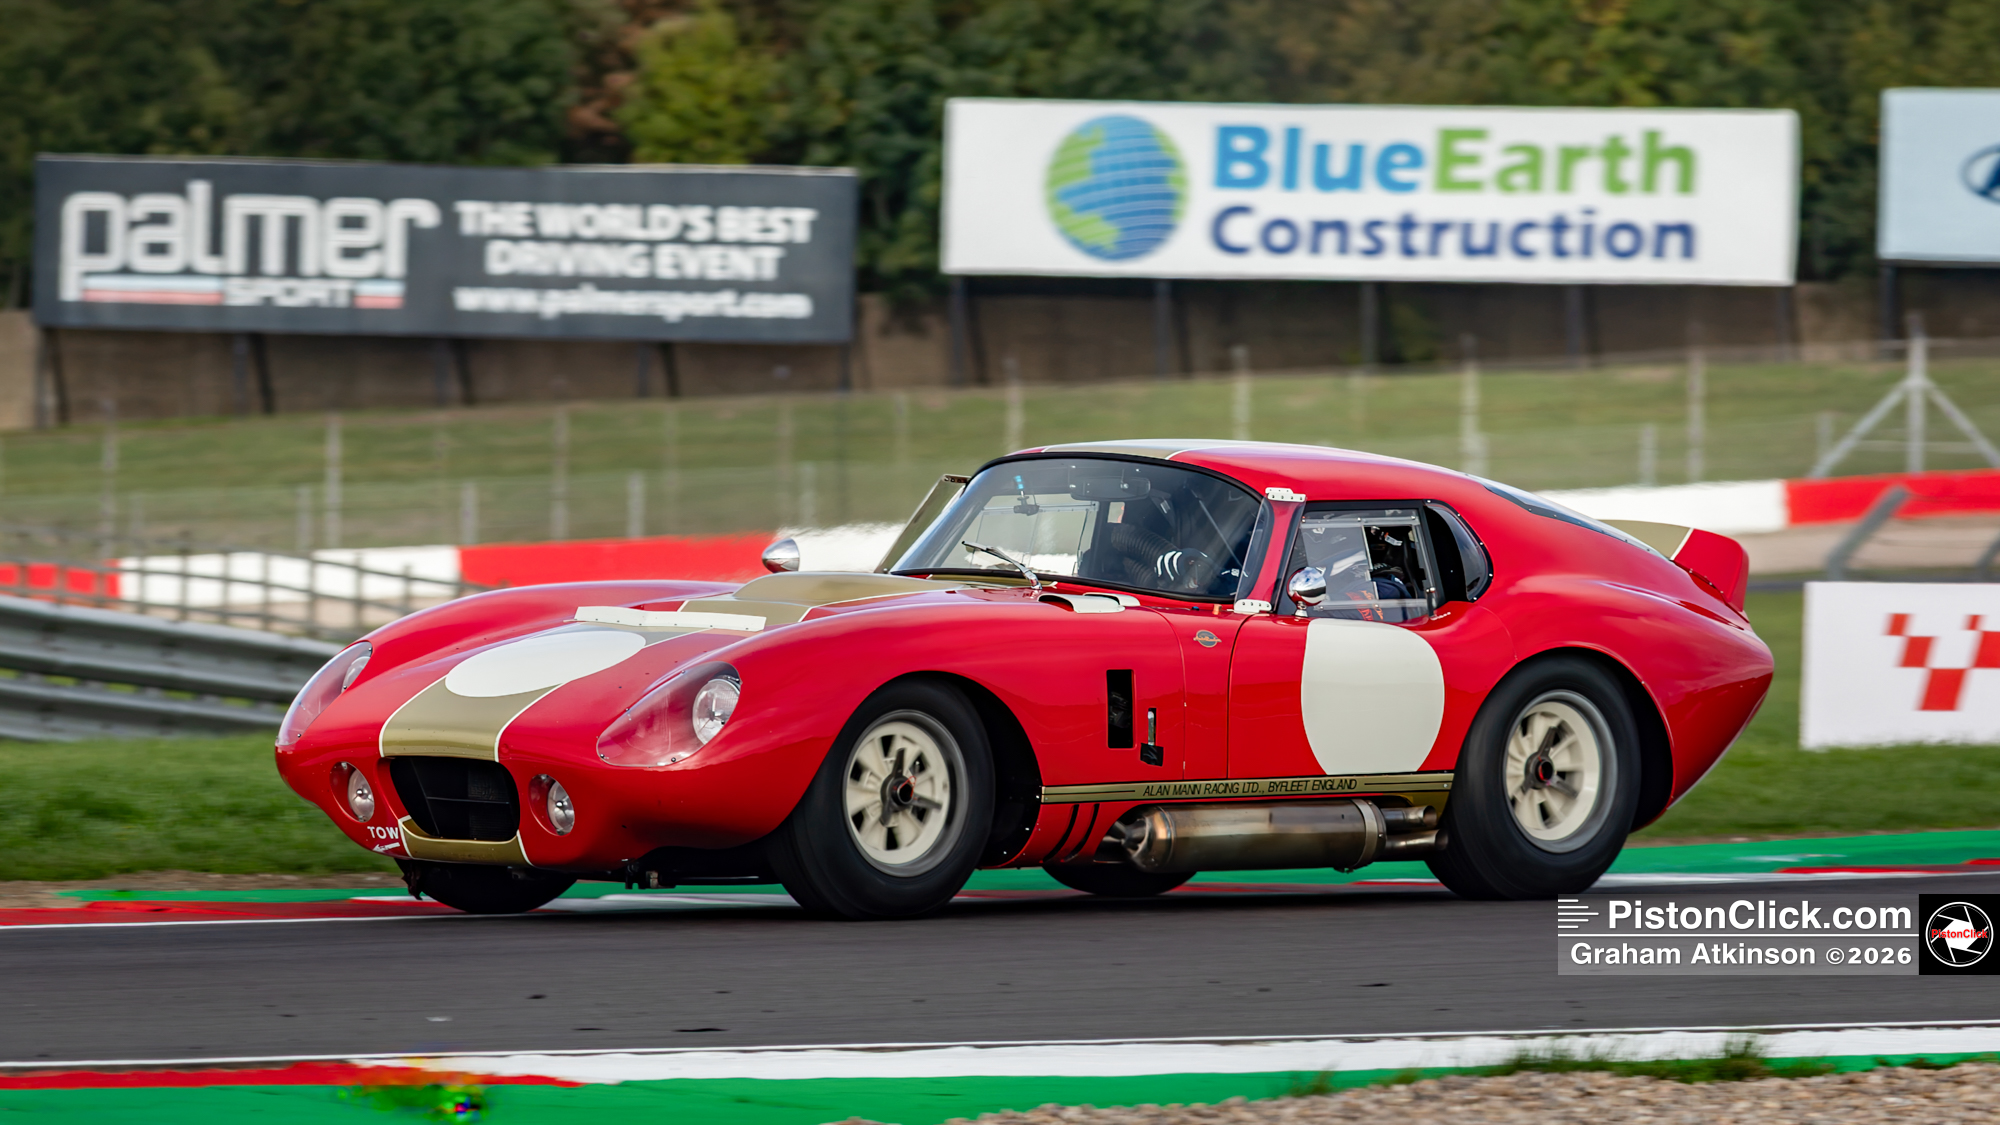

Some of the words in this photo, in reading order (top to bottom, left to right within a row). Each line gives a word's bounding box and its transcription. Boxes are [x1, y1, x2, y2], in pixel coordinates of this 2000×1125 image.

[1213, 124, 1697, 195] BlueEarth
[59, 180, 441, 302] palmer
[455, 201, 534, 237] THE
[534, 203, 714, 242] WORLD'S
[717, 207, 817, 244] BEST
[1211, 206, 1697, 260] Construction
[485, 240, 652, 278] DRIVING
[655, 244, 786, 281] EVENT
[224, 277, 354, 308] SPORT
[1143, 784, 1170, 797] ALAN
[1172, 783, 1201, 796] MANN
[1203, 781, 1239, 795] RACING
[1268, 779, 1309, 792] BYFLEET
[1312, 778, 1357, 791] ENGLAND
[367, 825, 399, 839] TOW
